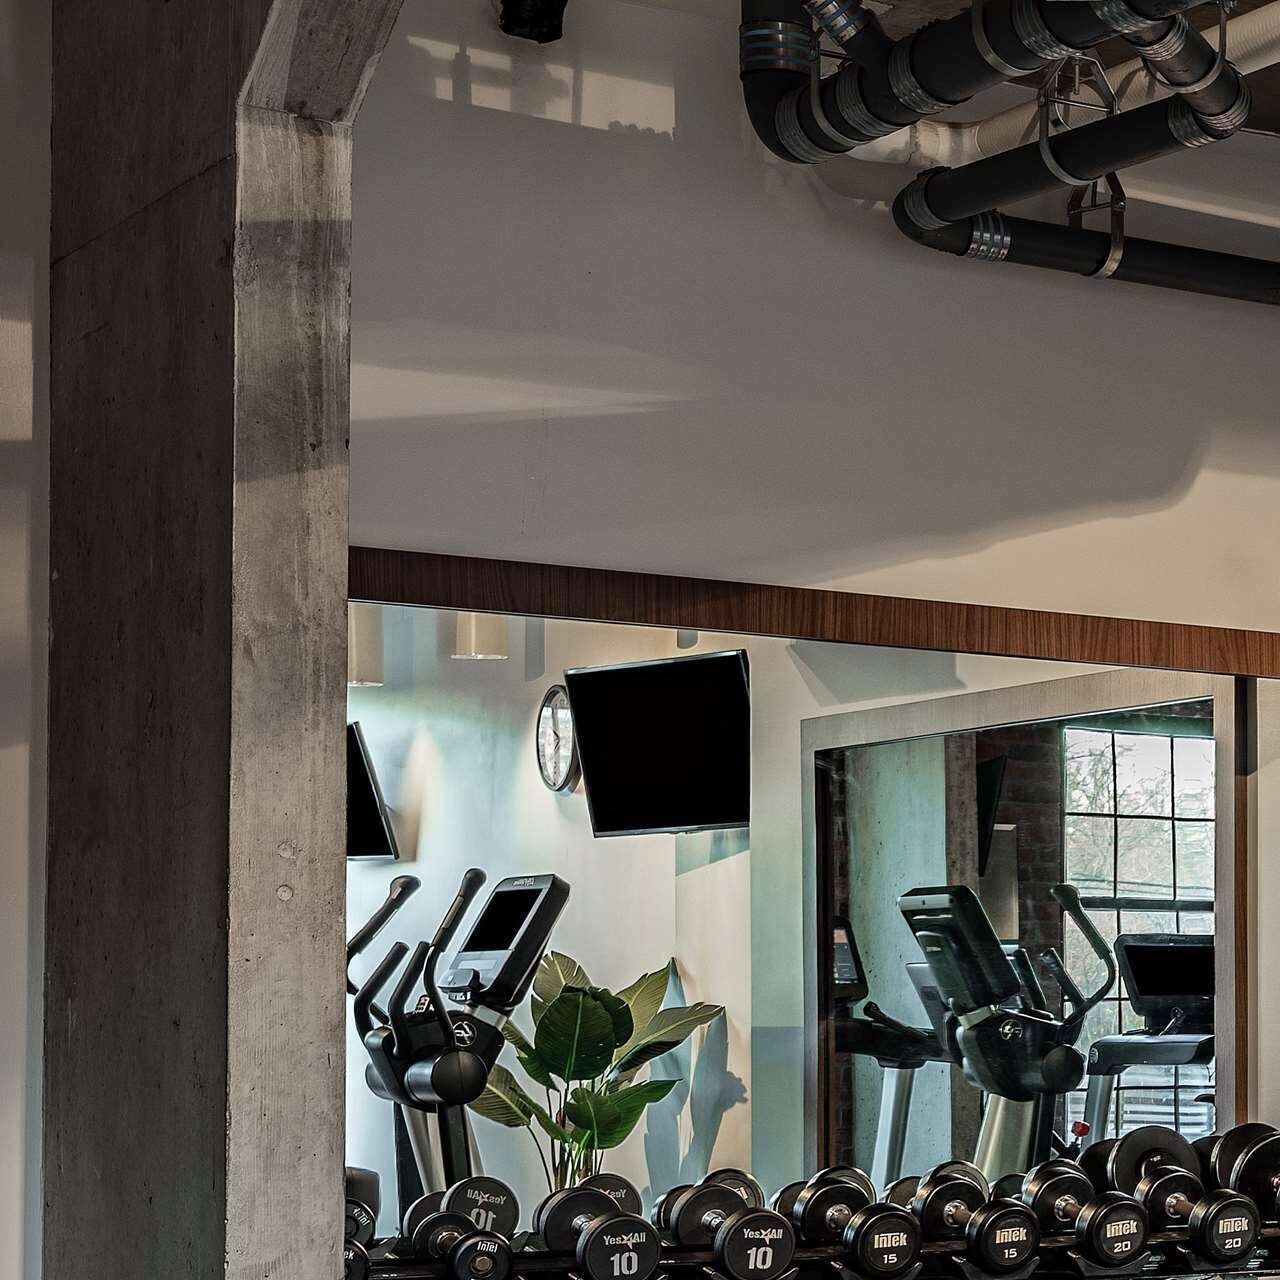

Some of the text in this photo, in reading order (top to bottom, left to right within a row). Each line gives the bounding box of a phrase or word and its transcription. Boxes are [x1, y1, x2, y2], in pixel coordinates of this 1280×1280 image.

[1106, 1219, 1138, 1238] InTek
[1219, 1217, 1249, 1234] InTek
[874, 1232, 908, 1249] InTek
[996, 1227, 1027, 1244] InTek
[1225, 1237, 1242, 1249] 20
[1004, 1248, 1018, 1259] 15
[1114, 1241, 1131, 1253] 20
[609, 1252, 639, 1276] 10
[747, 1247, 773, 1270] 10
[883, 1253, 898, 1264] 15
